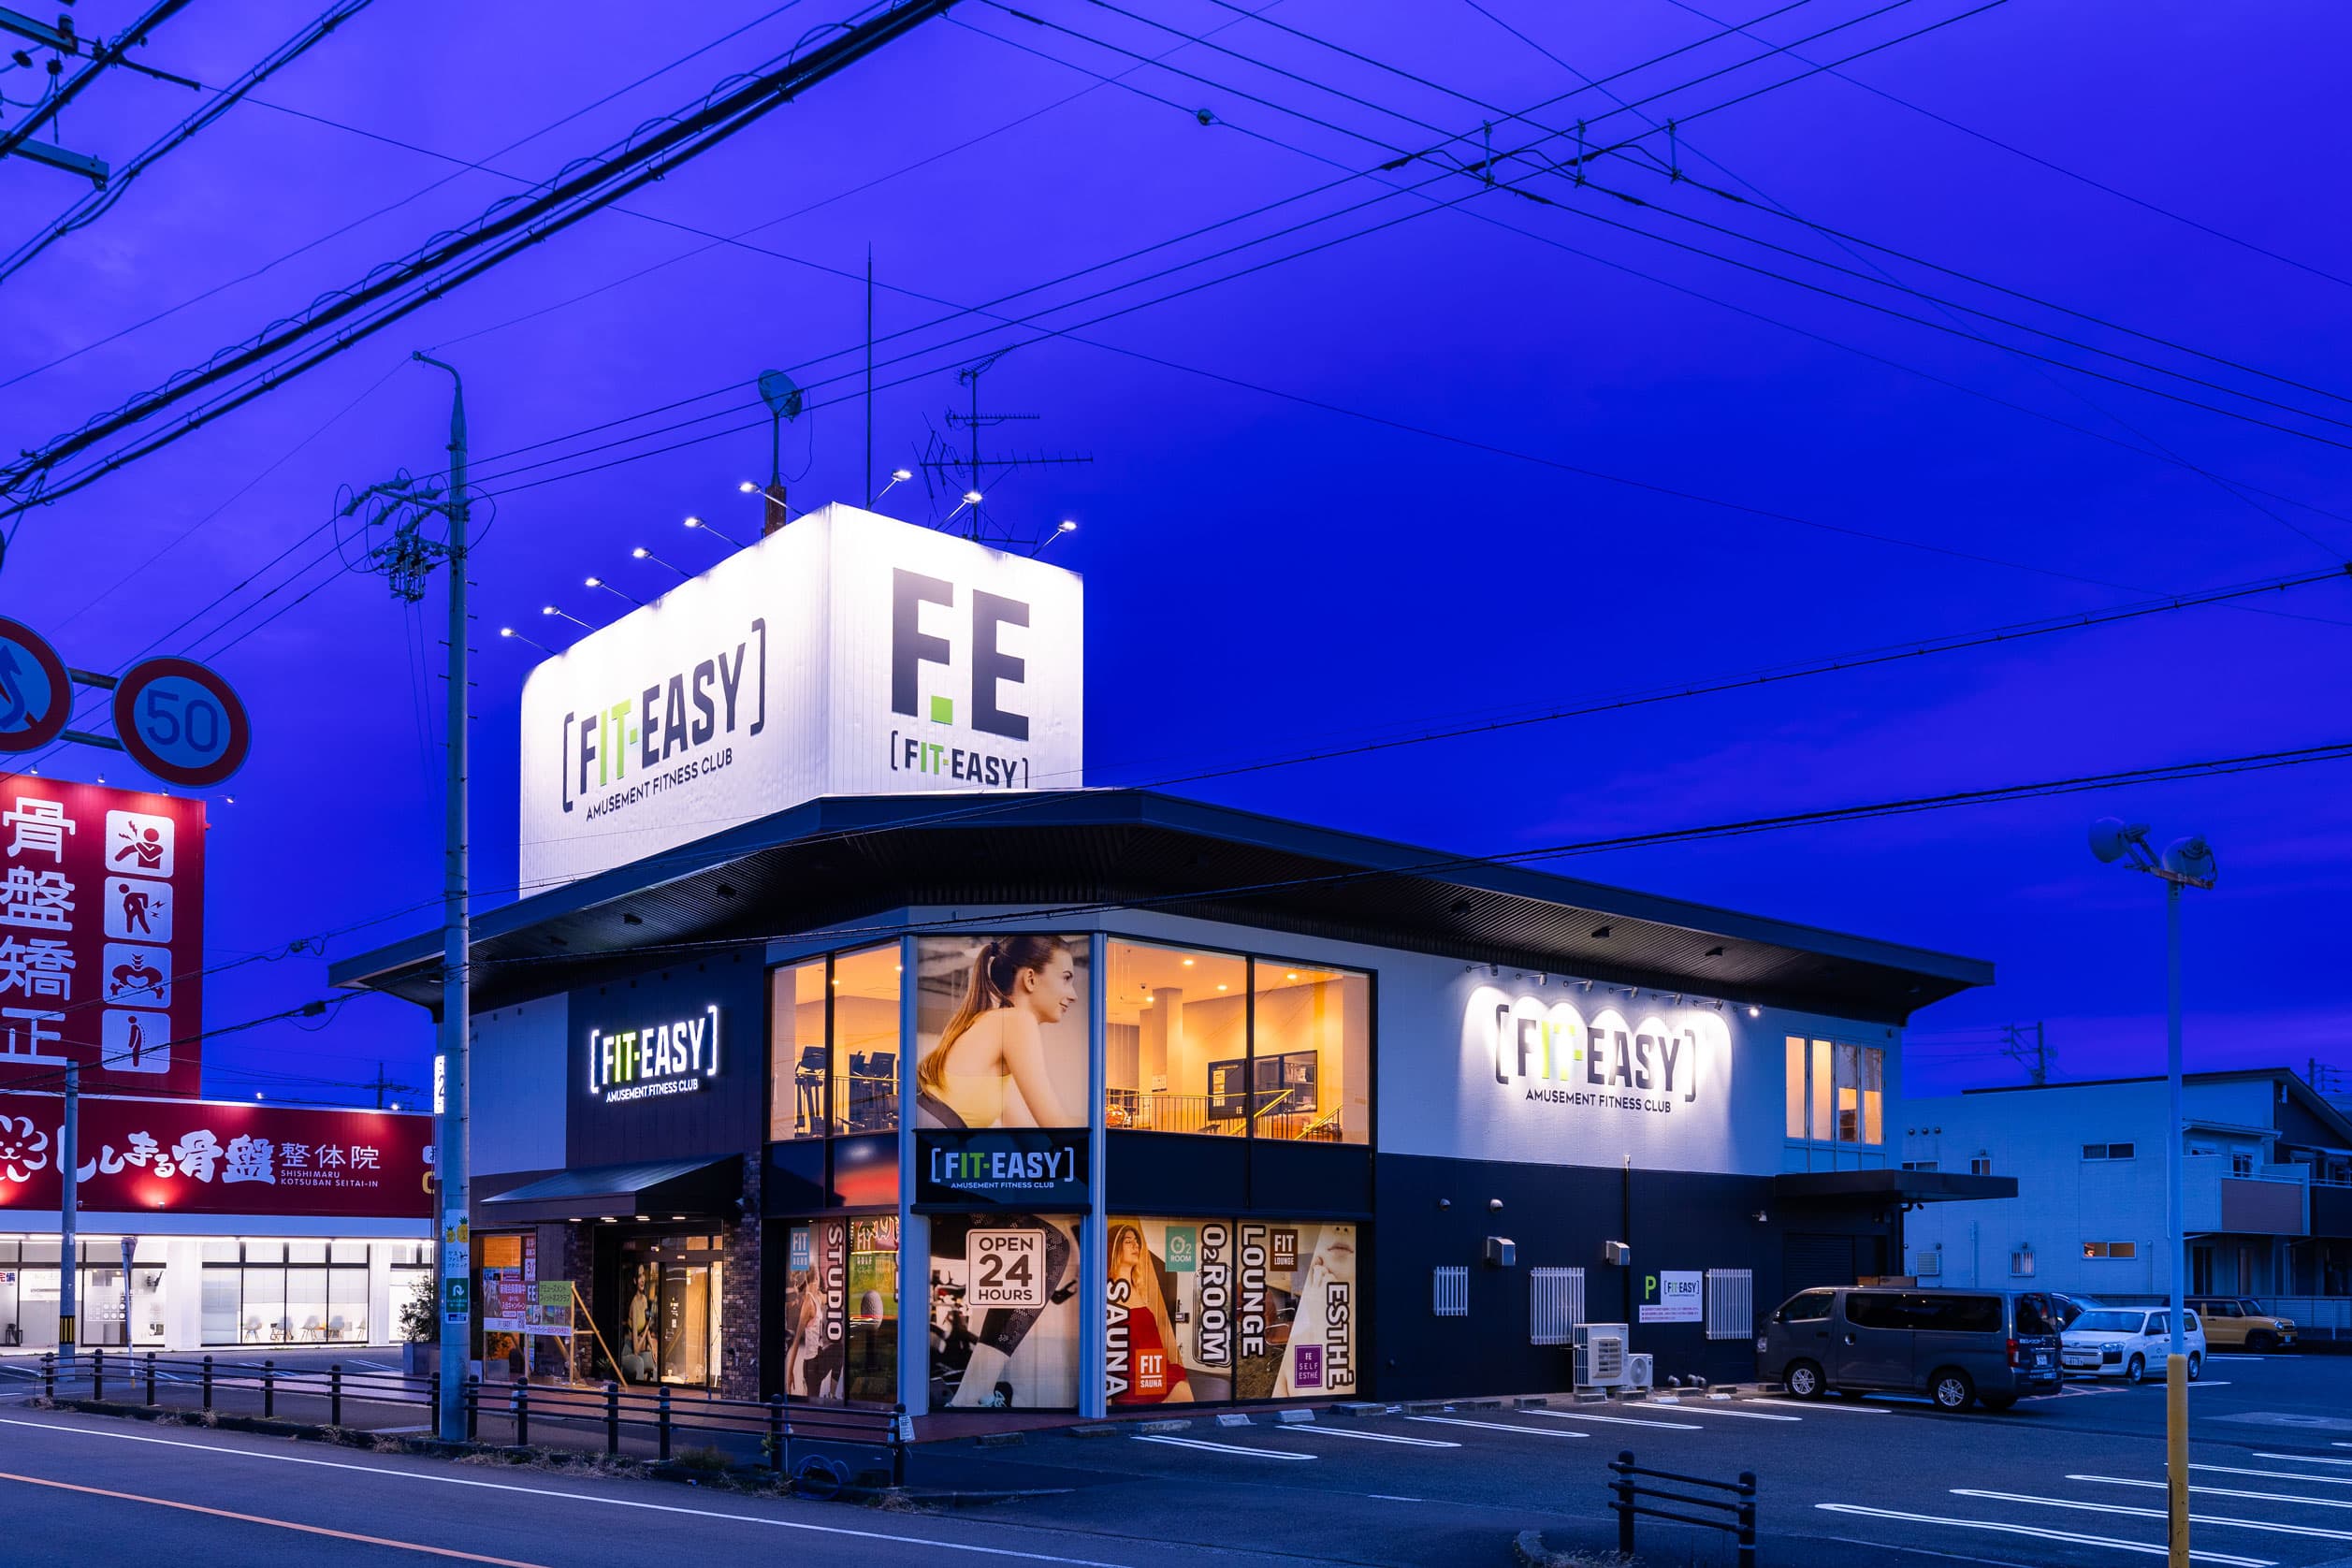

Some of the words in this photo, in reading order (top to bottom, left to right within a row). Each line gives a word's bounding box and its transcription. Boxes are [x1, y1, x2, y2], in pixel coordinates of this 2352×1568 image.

[147, 690, 218, 752] 50
[587, 781, 650, 822] AMUSEMENT
[653, 762, 699, 795] FITNESS
[701, 748, 733, 775] CLUB
[0, 797, 76, 1067] 骨盤矯正
[606, 1086, 648, 1103] AMUSEMENT
[648, 1082, 677, 1096] FITNESS
[678, 1079, 699, 1091] CLUB
[1526, 1089, 1595, 1106] AMUSEMENT
[1599, 1095, 1642, 1111] FITNESS
[1644, 1099, 1671, 1113] CLUB
[279, 1142, 381, 1169] 整体院
[281, 1169, 341, 1179] SHISHIMARU
[281, 1178, 331, 1186] KOTSUBAN
[335, 1179, 379, 1187] SEITAI-IN
[793, 1232, 808, 1251] FIT
[979, 1237, 1033, 1252] OPEN
[1274, 1234, 1295, 1252] FIT
[979, 1254, 1033, 1287] 24
[1273, 1257, 1295, 1266] LOUNGE
[827, 1226, 843, 1341] STUDIO
[979, 1289, 1033, 1300] HOURS
[1242, 1227, 1265, 1357] LOUNGE
[1646, 1275, 1657, 1299] P
[1202, 1265, 1226, 1360] ROOM
[1106, 1280, 1128, 1398] SAUNA
[1328, 1284, 1354, 1387] ESTHÉ
[1140, 1355, 1163, 1374] FIT
[1140, 1379, 1163, 1388] SAUNA
